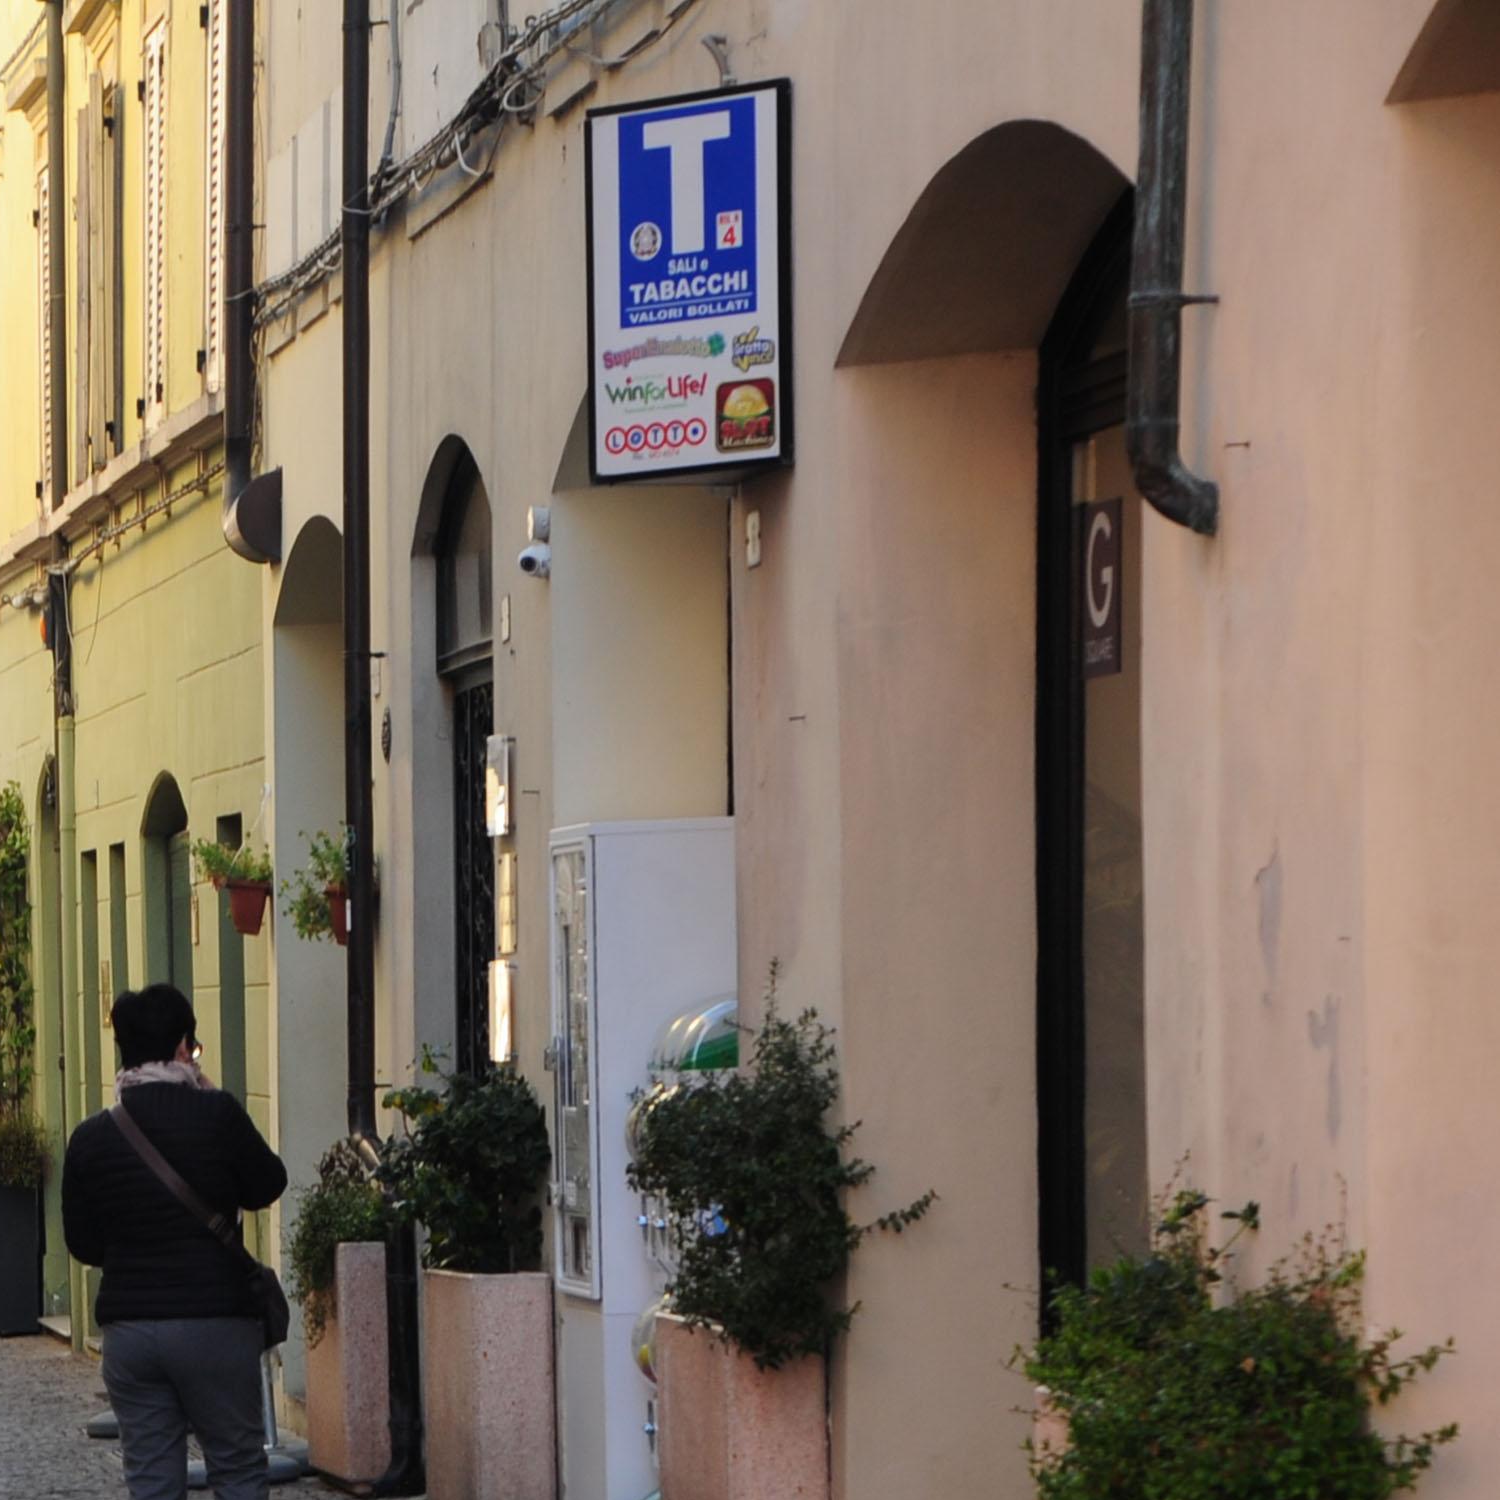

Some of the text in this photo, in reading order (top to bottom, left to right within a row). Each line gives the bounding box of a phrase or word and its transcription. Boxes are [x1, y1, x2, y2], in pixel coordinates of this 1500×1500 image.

[642, 110, 731, 255] T
[722, 225, 737, 246] 4
[668, 256, 697, 275] SALI
[629, 270, 748, 304] TABACCHI
[629, 299, 749, 324] VALORI BOLLATI
[1086, 511, 1114, 628] G
